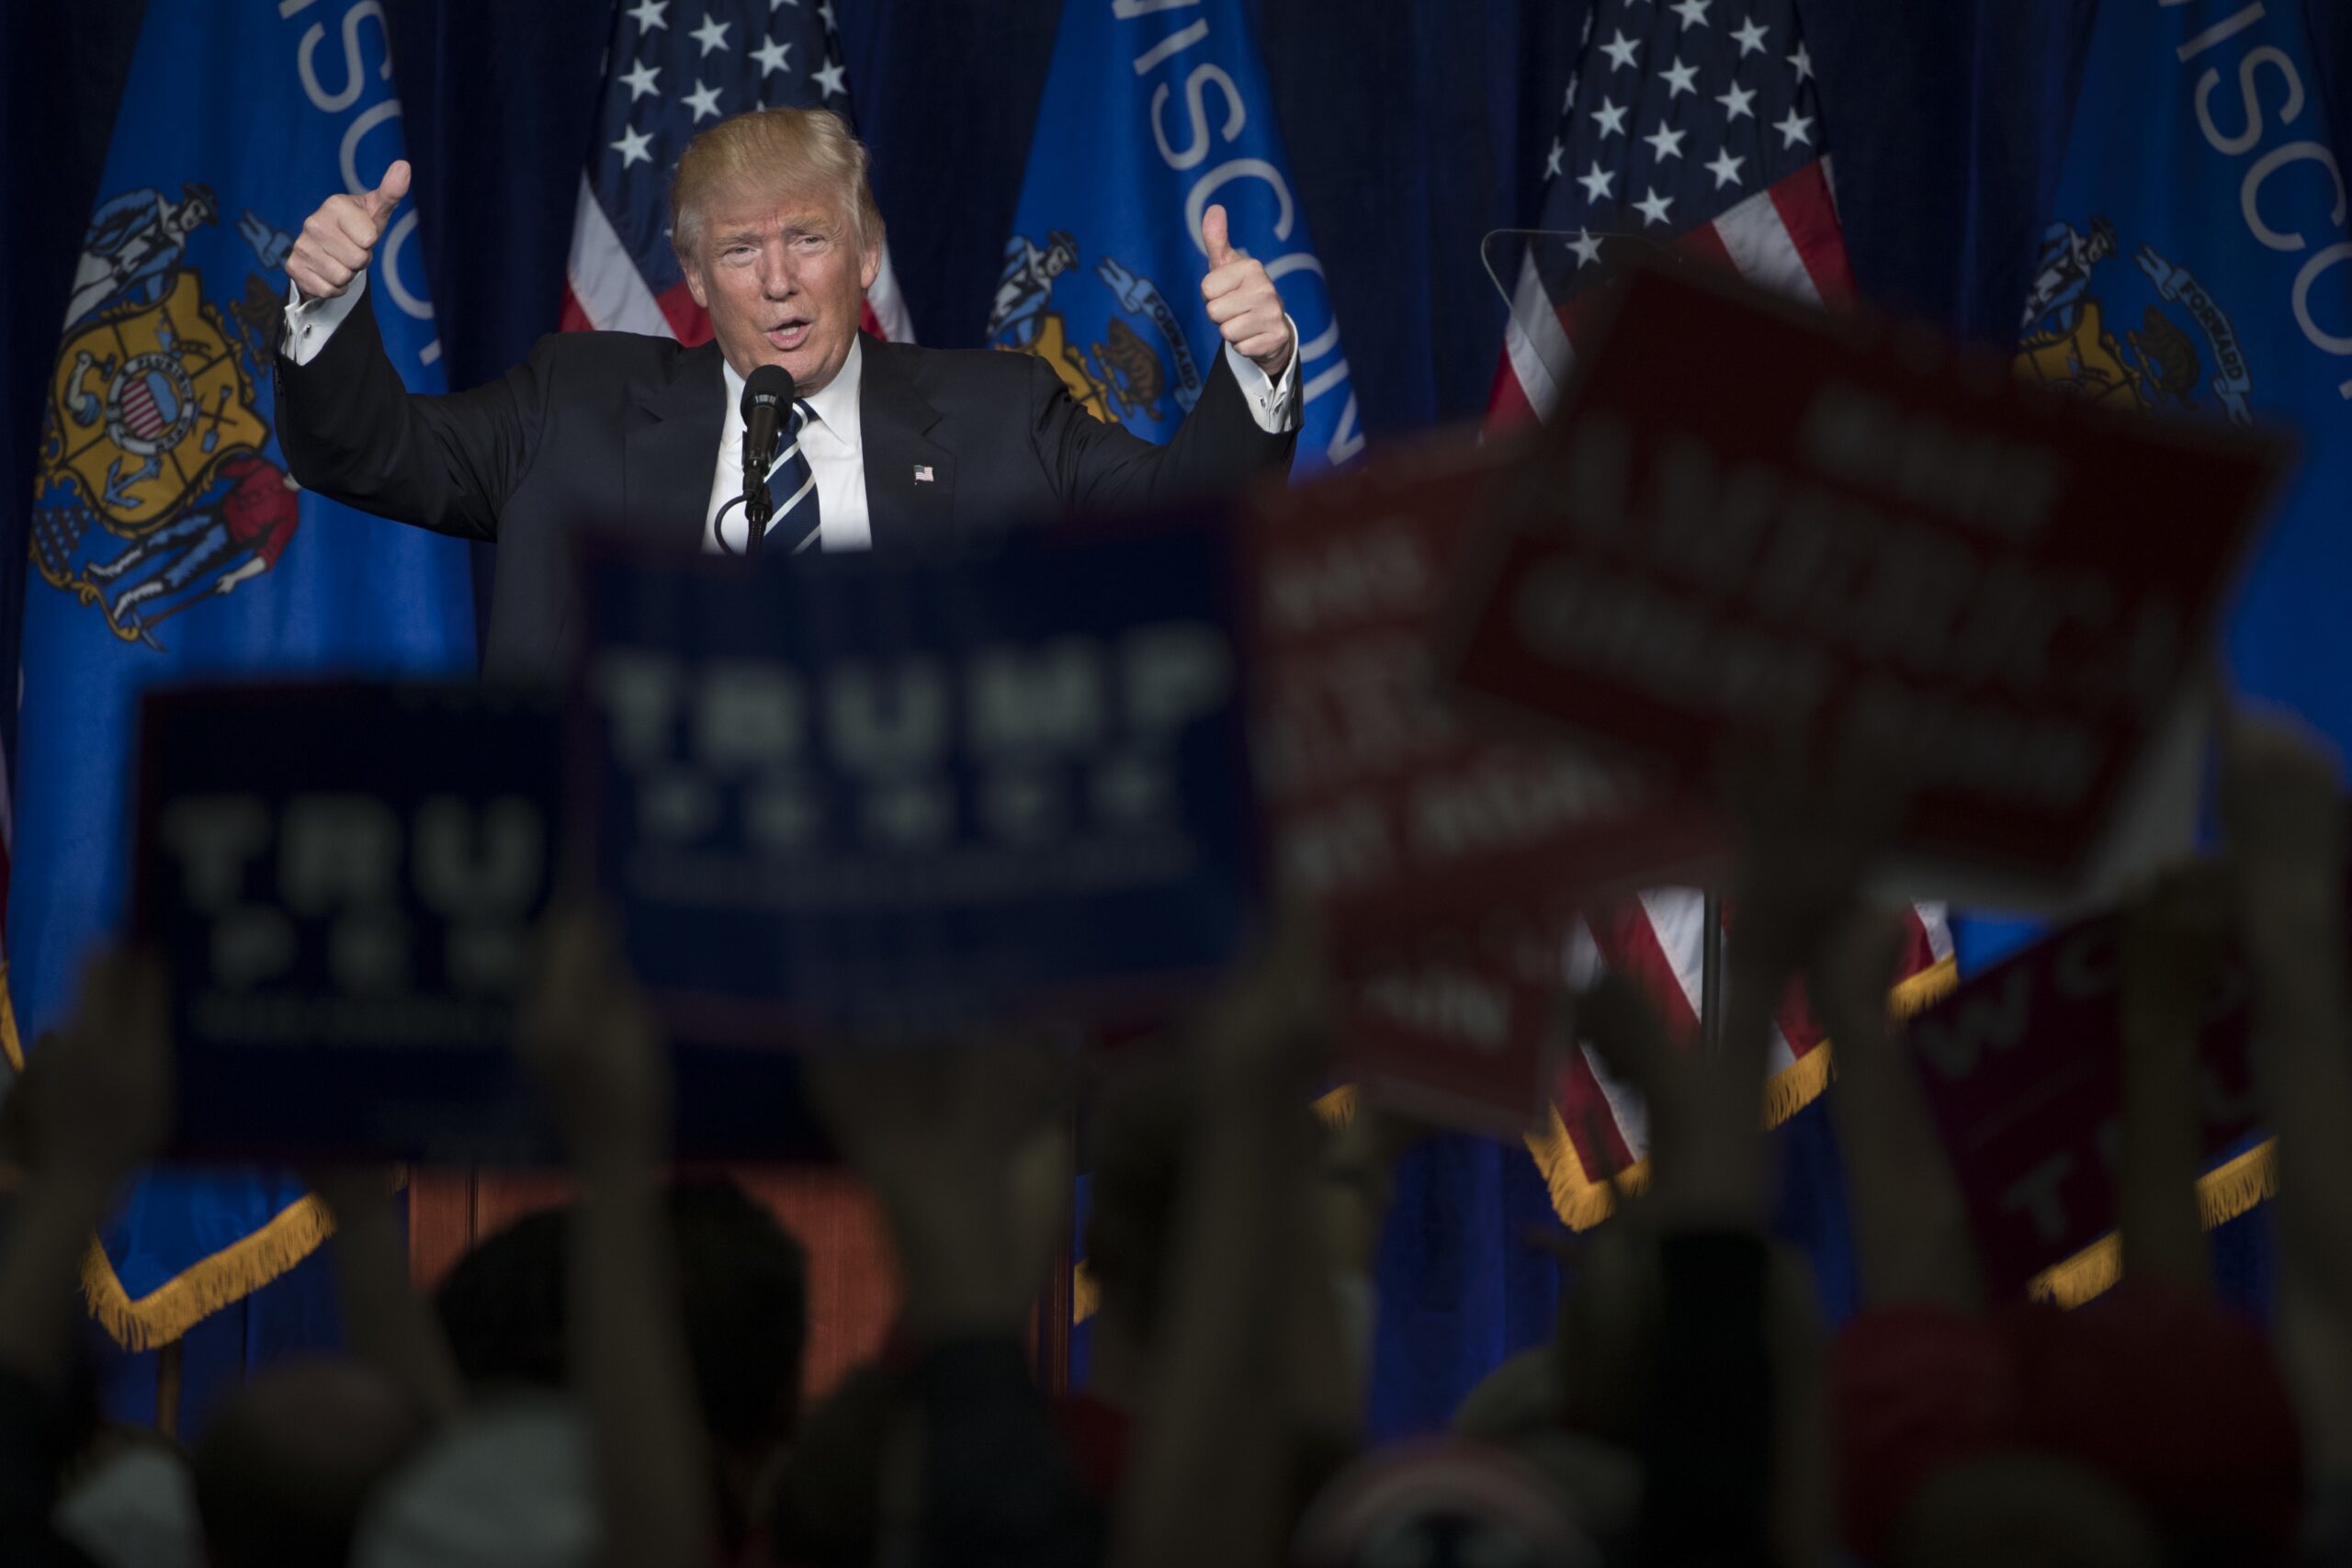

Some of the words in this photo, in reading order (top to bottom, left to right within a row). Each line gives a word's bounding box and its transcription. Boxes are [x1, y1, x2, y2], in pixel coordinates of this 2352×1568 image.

[2158, 0, 2352, 400] ISCO
[1145, 294, 1198, 389] FORWARD
[2181, 281, 2243, 379] FORWARD
[591, 625, 1231, 770] TRUMP
[160, 795, 547, 920] TRU
